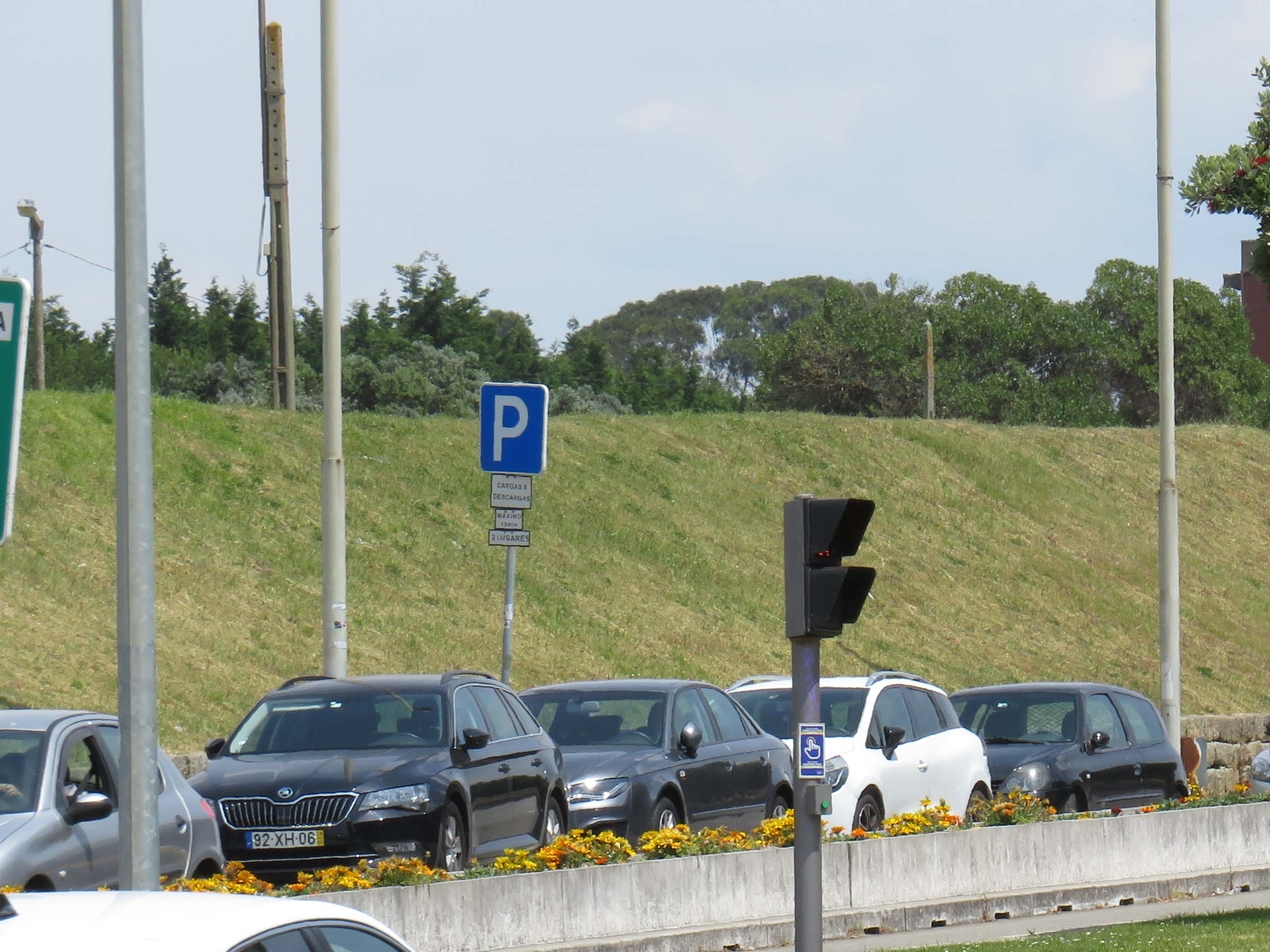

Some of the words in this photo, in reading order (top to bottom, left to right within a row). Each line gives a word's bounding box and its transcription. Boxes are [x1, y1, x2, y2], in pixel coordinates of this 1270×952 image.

[493, 395, 529, 462] P
[497, 482, 522, 490] CARGAS
[493, 493, 531, 502] DESCARGAS
[497, 534, 530, 542] LUGARES
